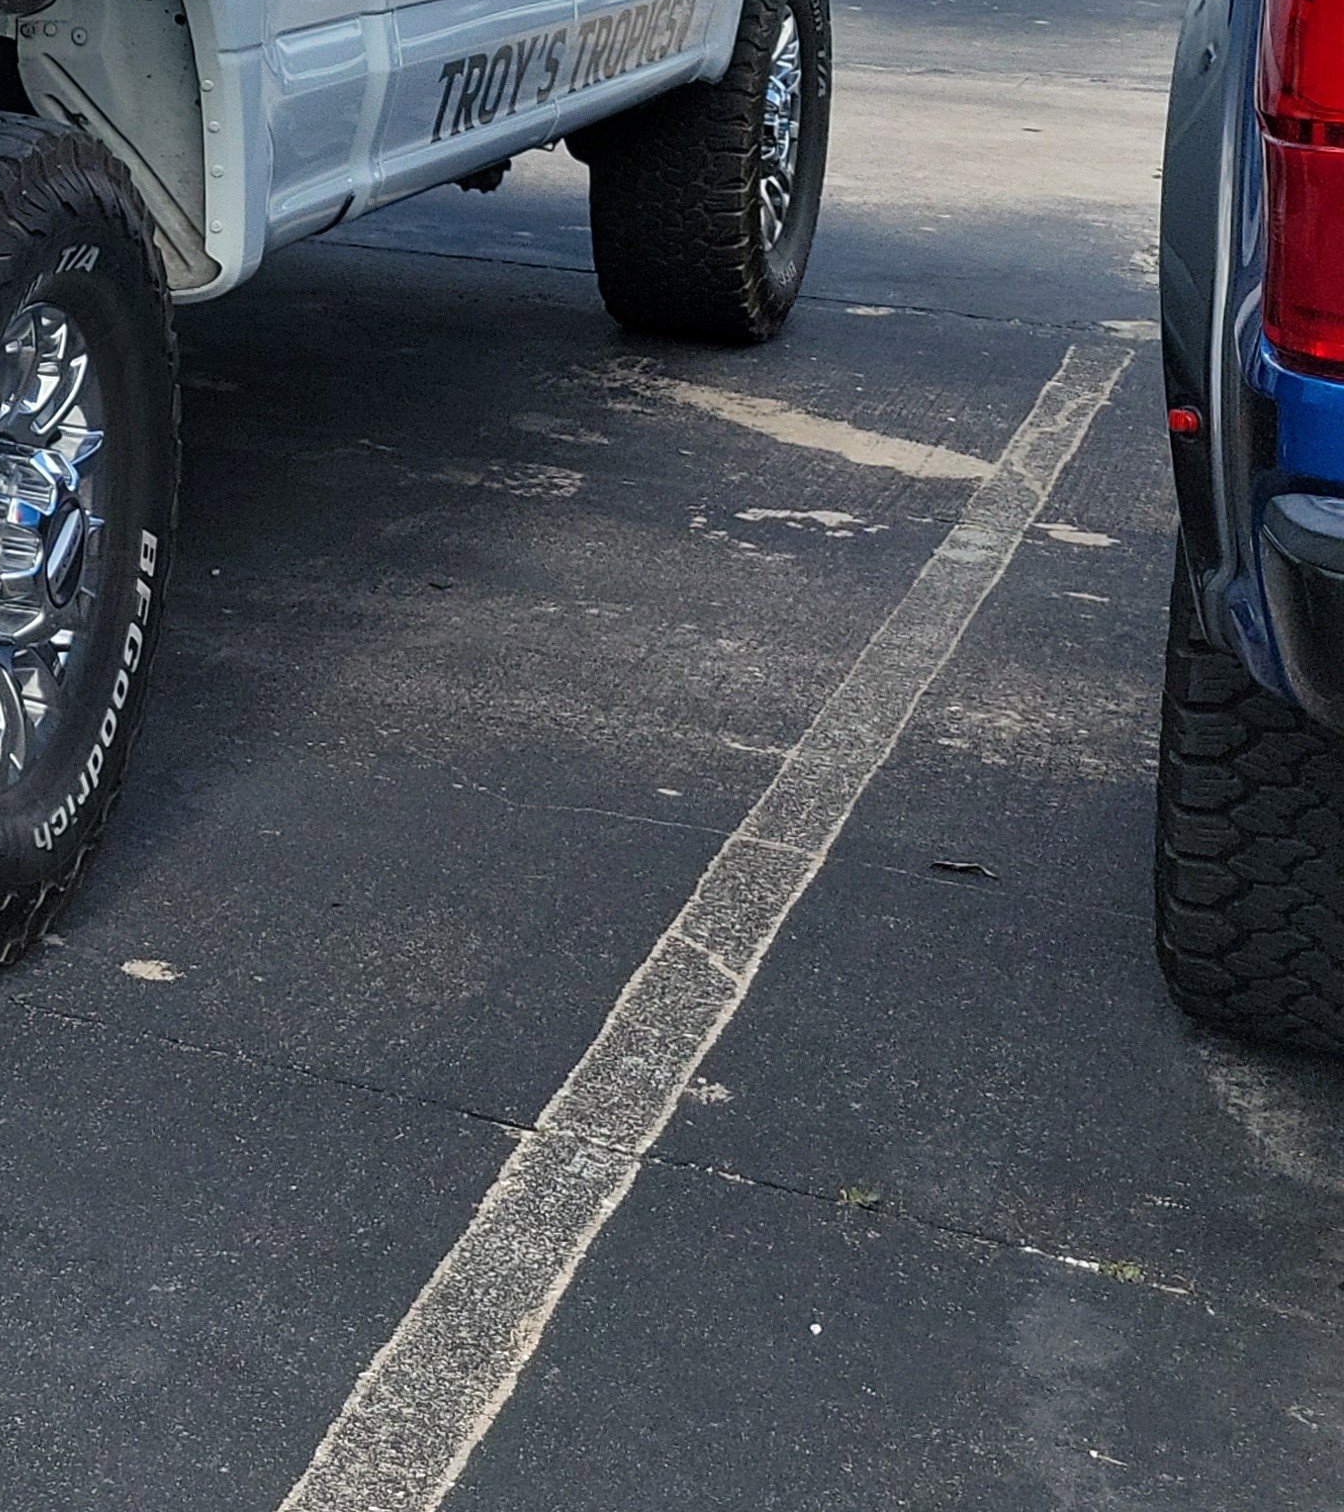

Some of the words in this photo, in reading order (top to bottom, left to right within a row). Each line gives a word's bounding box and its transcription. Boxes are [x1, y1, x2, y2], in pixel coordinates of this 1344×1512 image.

[430, 27, 567, 144] TROY'S
[55, 244, 100, 275] T/A
[34, 529, 158, 851] BFGoodrich
